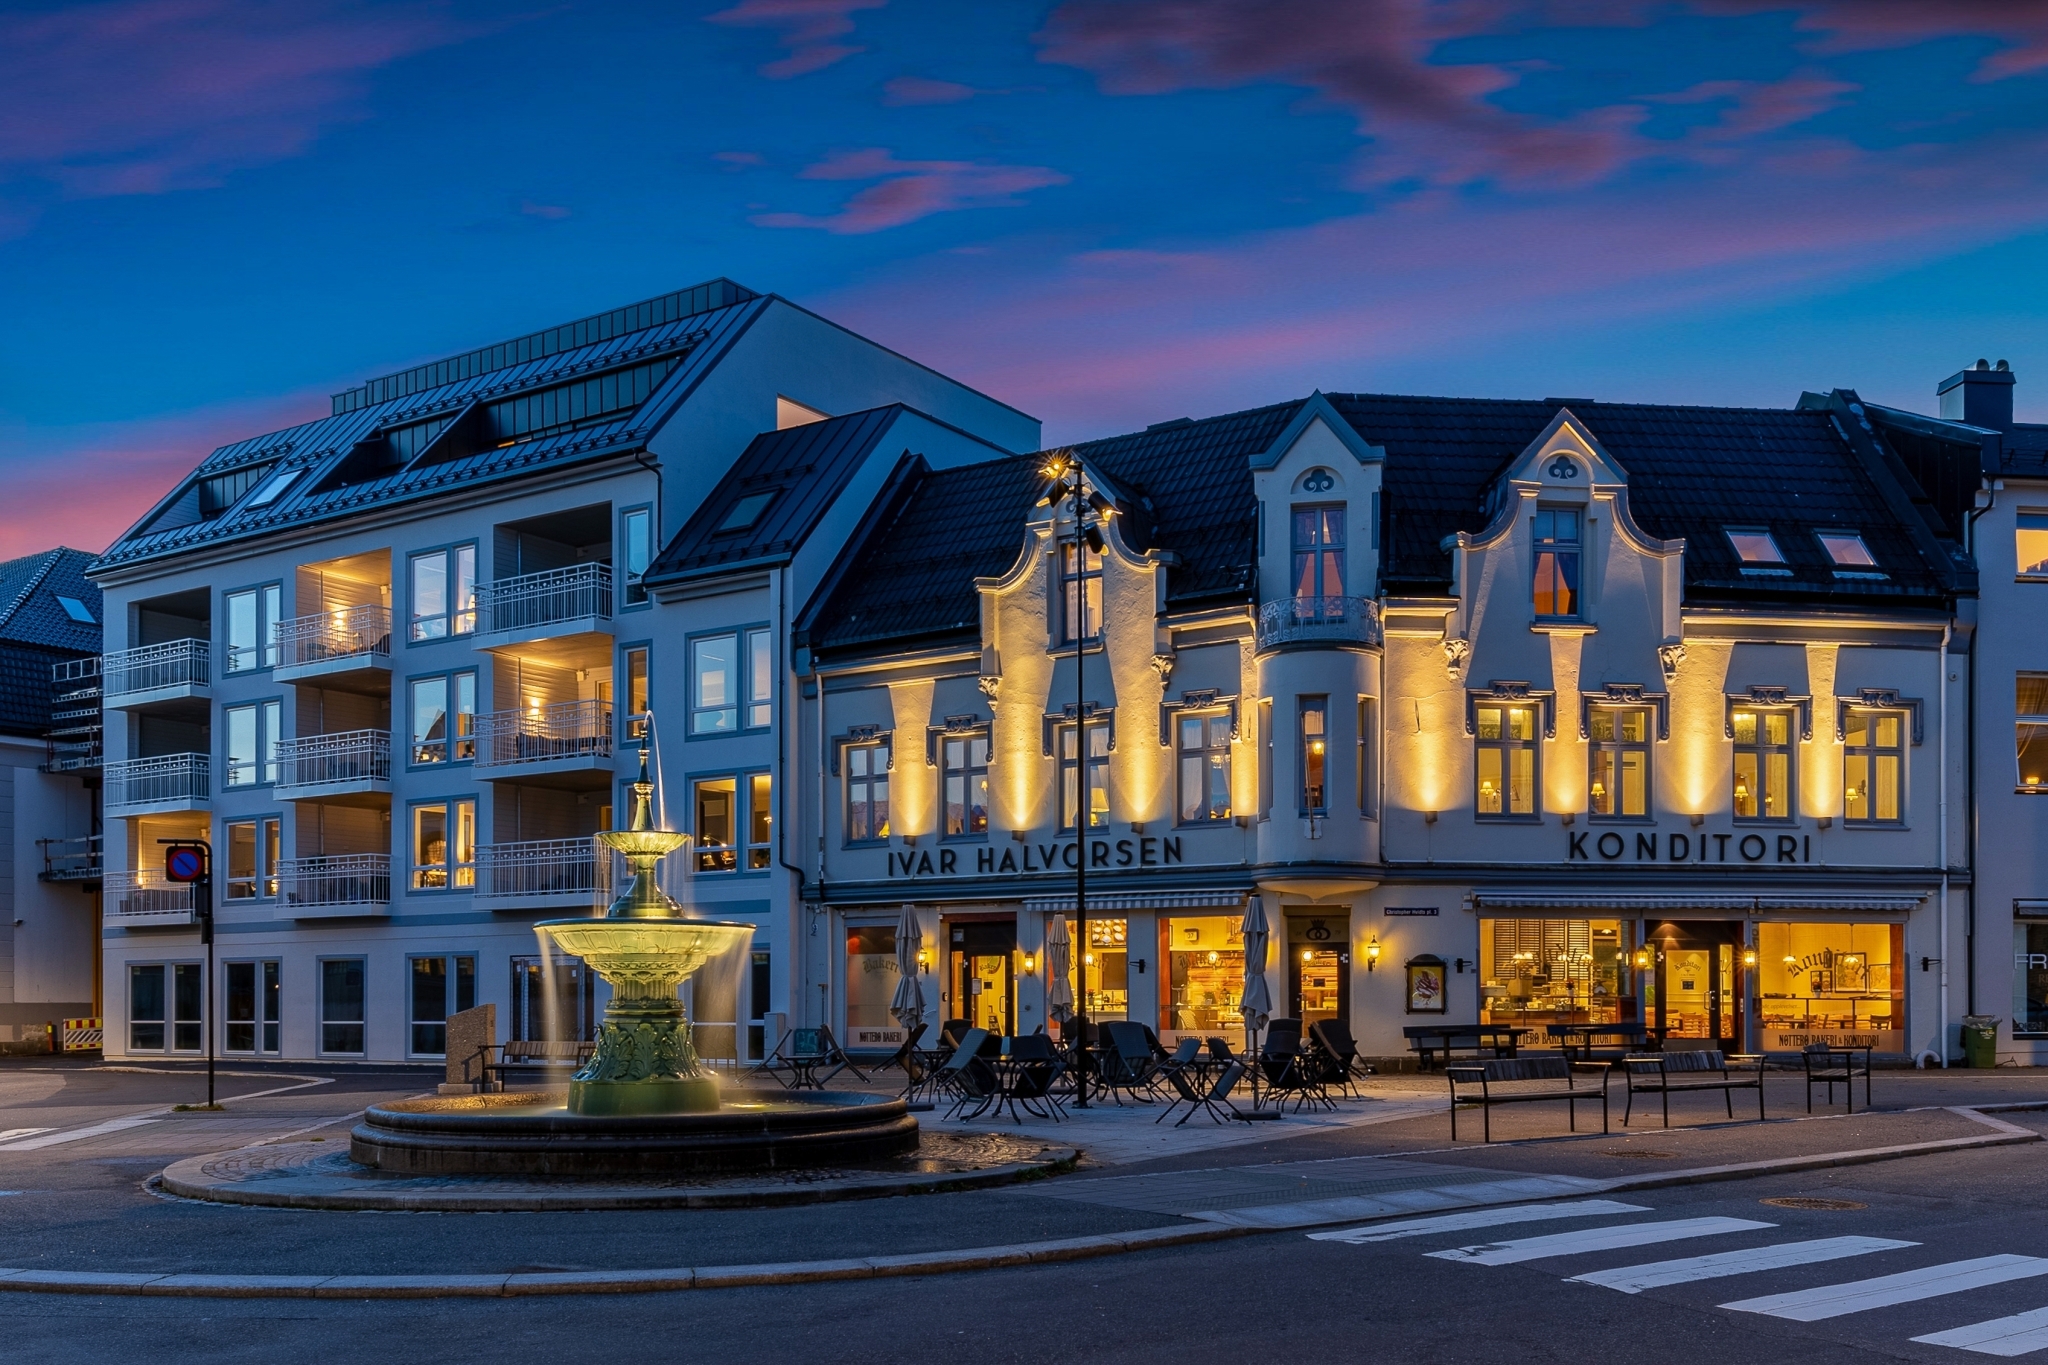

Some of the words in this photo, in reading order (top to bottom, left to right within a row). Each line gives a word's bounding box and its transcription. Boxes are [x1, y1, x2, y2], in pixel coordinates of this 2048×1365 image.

[888, 849, 958, 877] IVAR
[977, 836, 1183, 873] HALVORSEN
[1569, 831, 1810, 863] KONDITORI
[882, 1032, 902, 1042] BAKERI
[1844, 1034, 1880, 1046] KONDITORI
